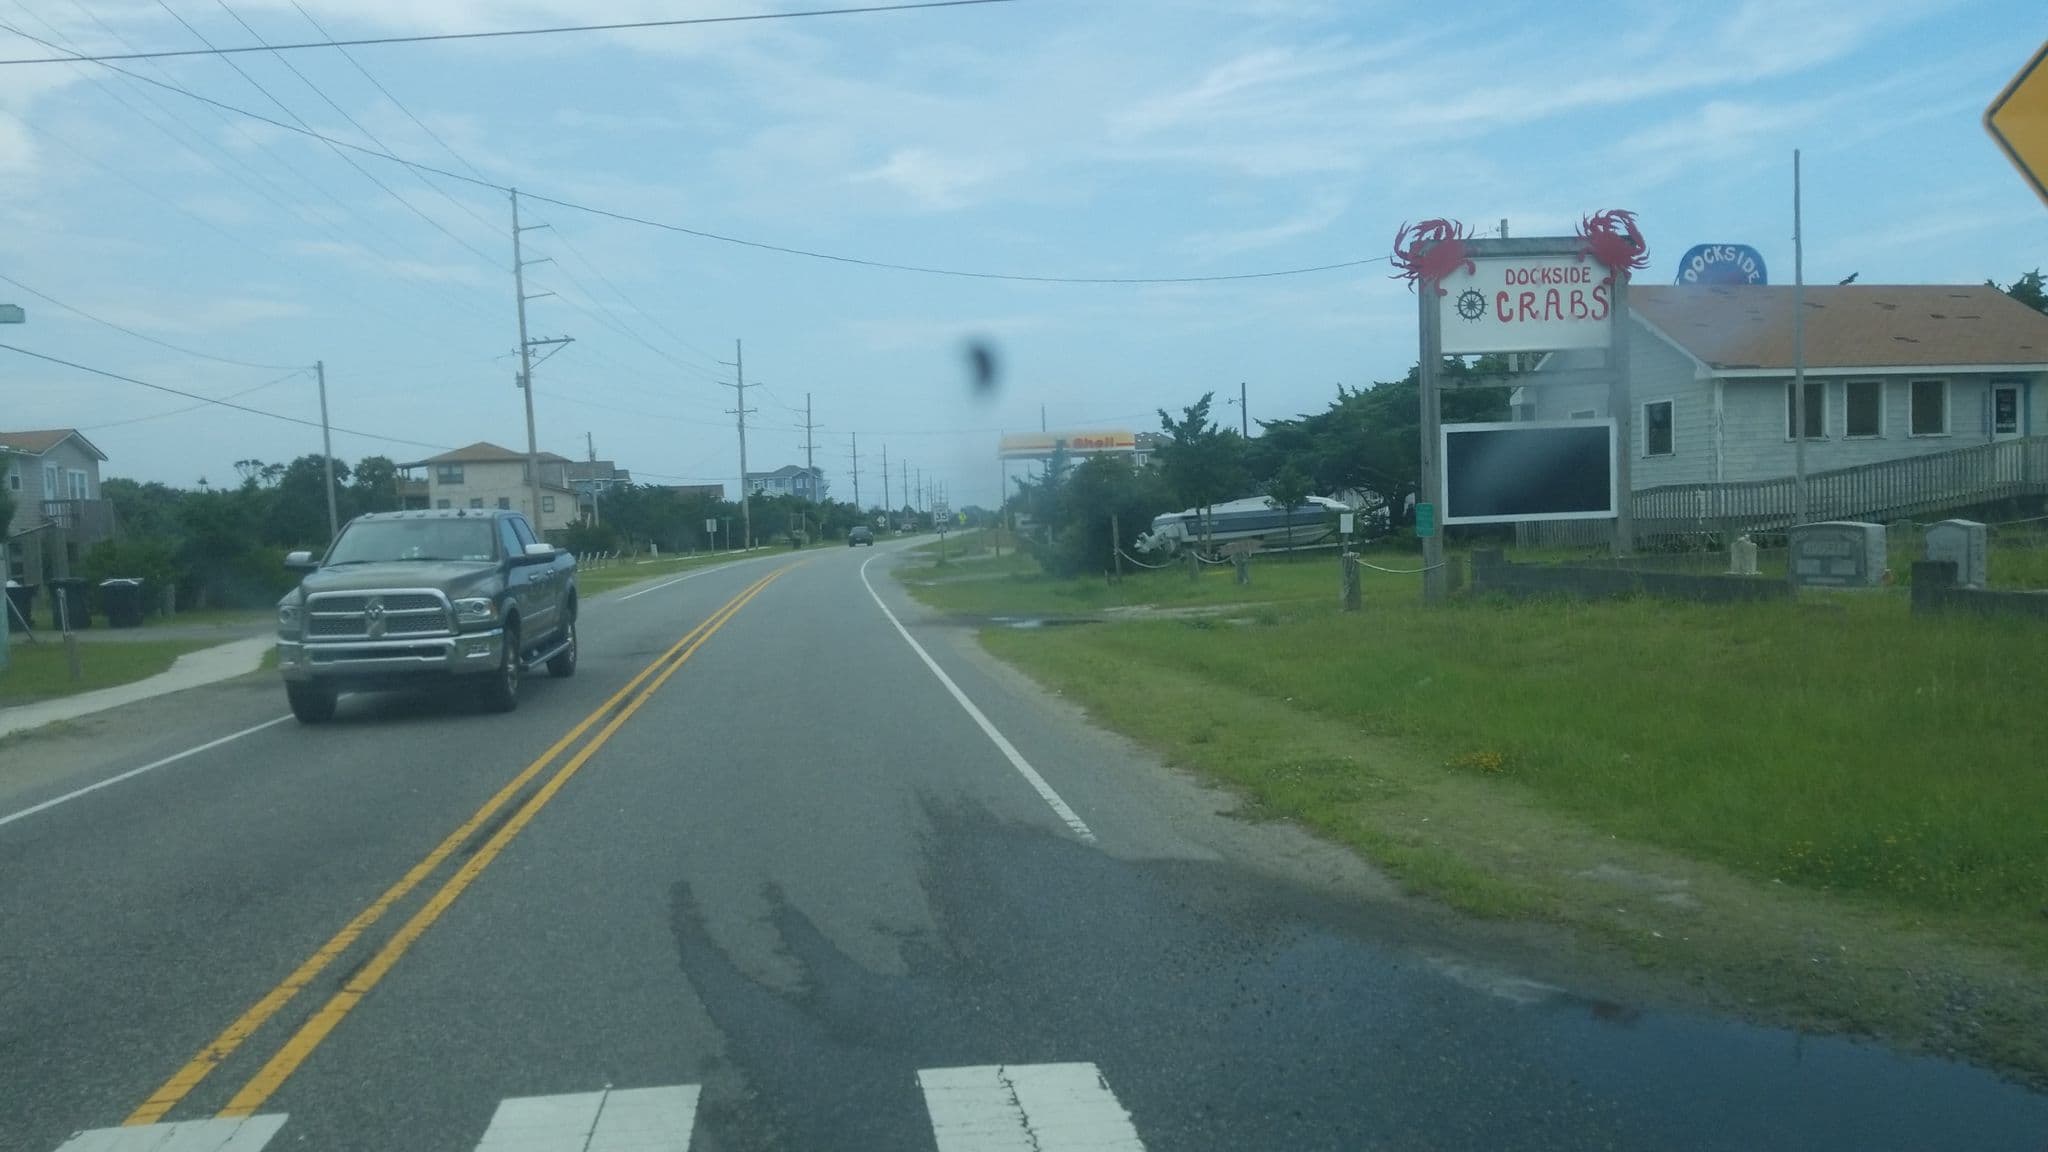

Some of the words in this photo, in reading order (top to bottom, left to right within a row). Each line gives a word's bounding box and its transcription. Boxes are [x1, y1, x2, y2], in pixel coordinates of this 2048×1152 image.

[1505, 267, 1591, 286] DOCKSIDE
[1684, 245, 1760, 284] DOCKSIDE
[1496, 285, 1609, 323] CRABS
